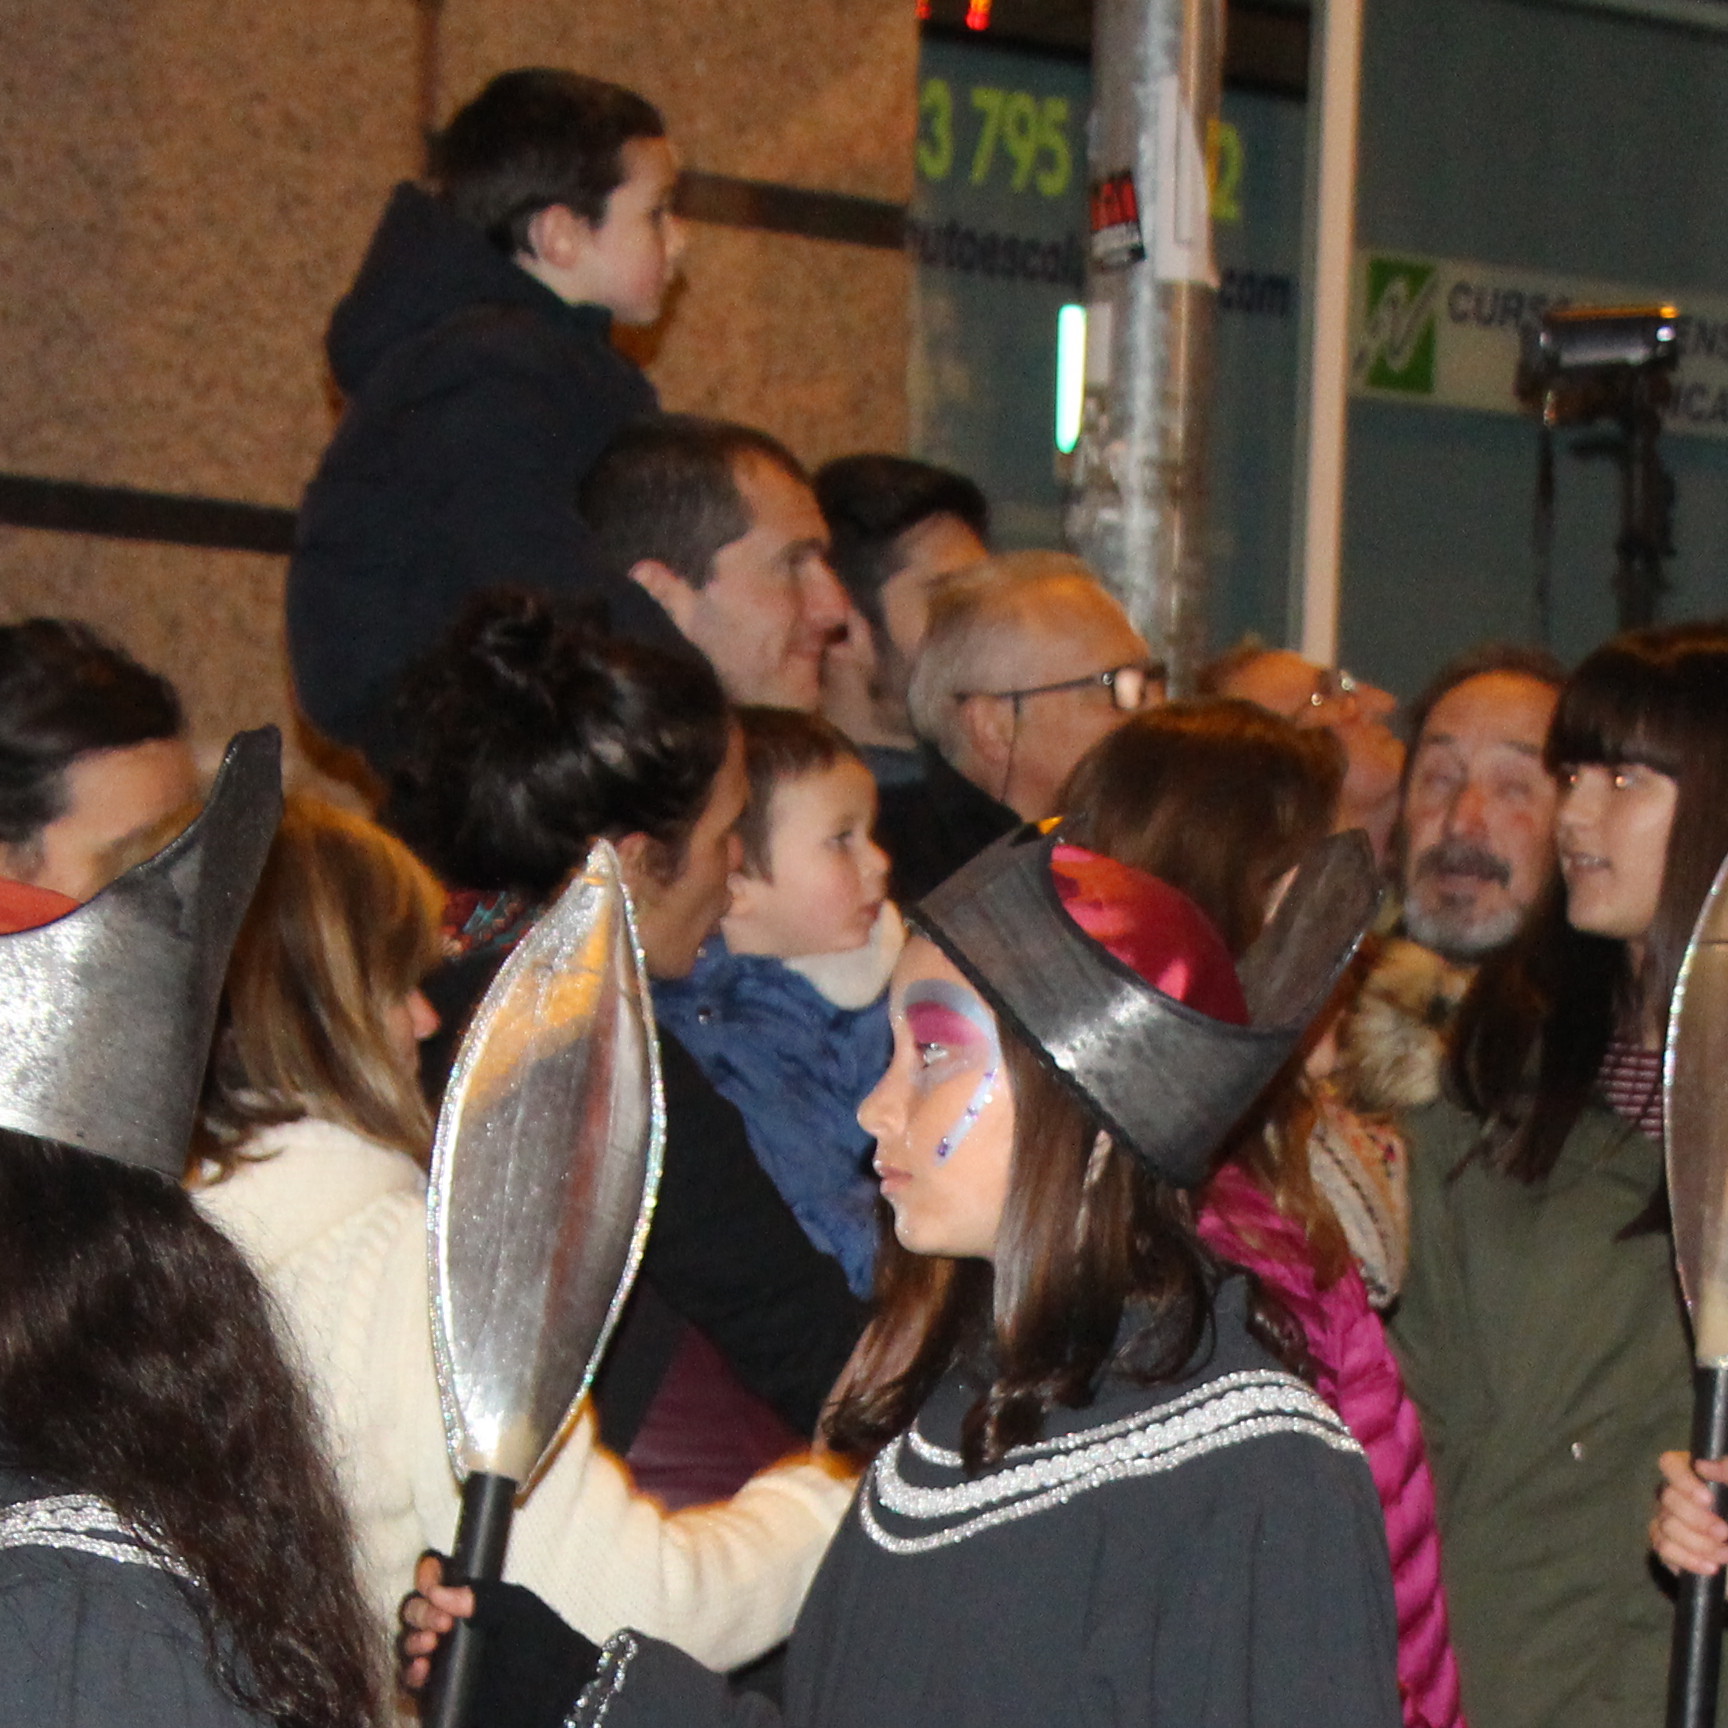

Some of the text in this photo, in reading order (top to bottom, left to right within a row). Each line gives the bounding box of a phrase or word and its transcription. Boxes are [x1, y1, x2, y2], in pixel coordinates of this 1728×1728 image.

[916, 78, 955, 182] 3
[971, 86, 1071, 197] 795
[1217, 267, 1295, 316] com
